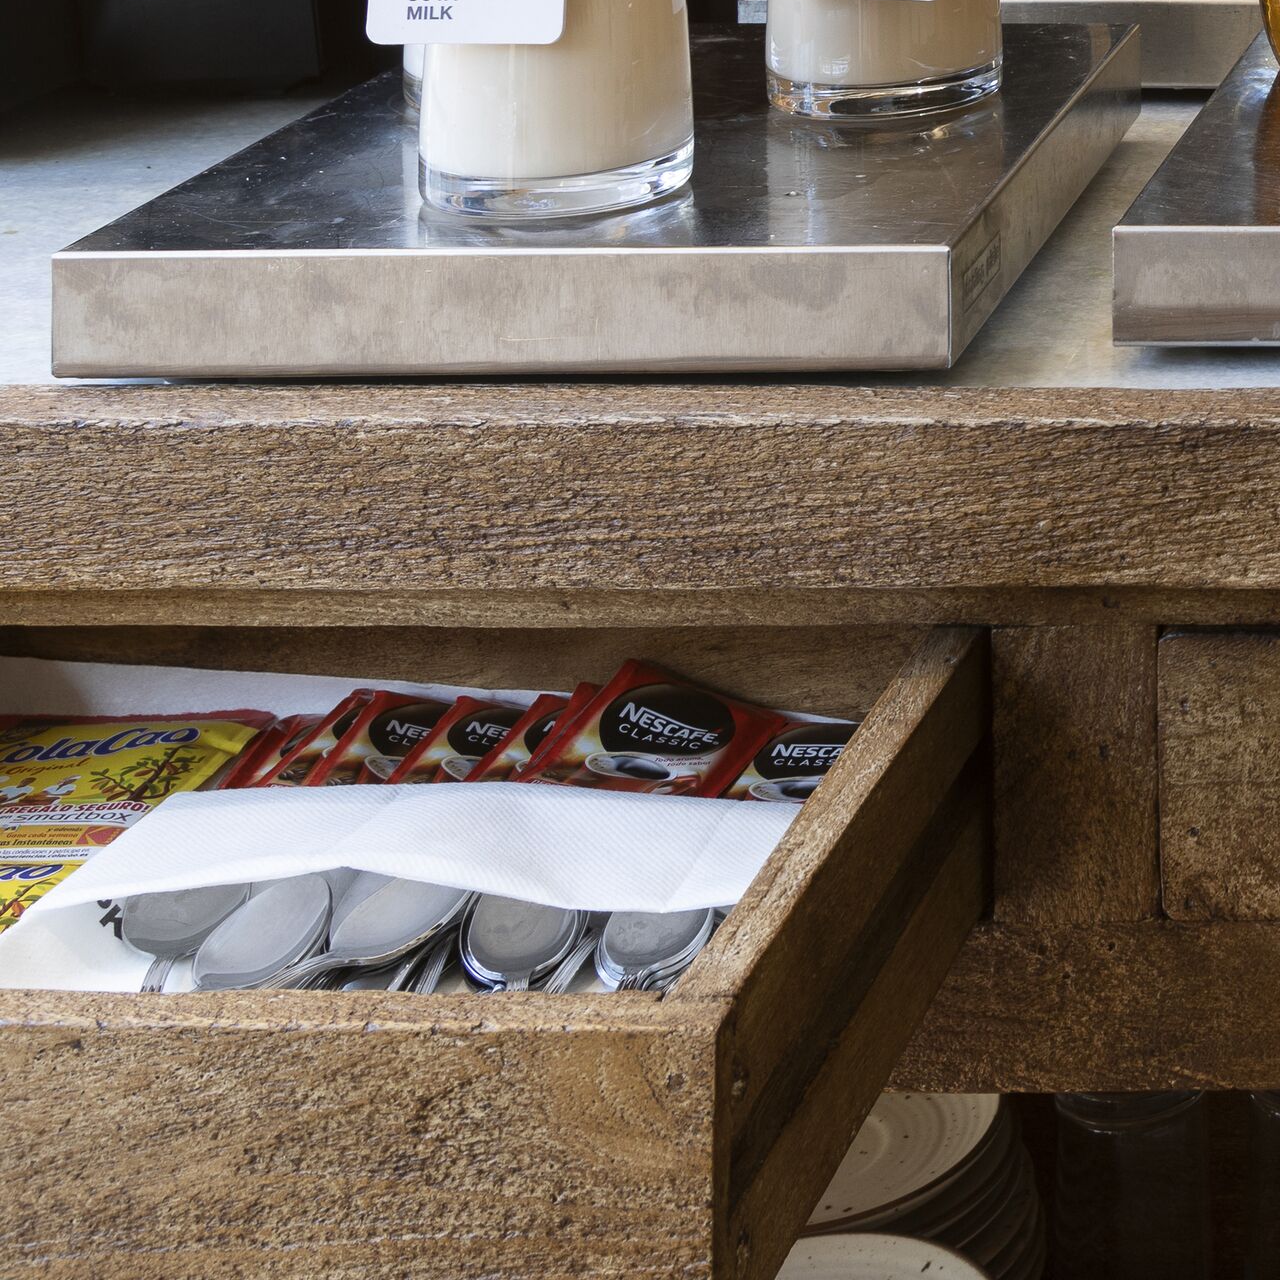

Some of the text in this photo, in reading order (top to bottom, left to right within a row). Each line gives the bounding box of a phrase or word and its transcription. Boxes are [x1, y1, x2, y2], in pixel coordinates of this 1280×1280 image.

[407, 6, 453, 20] MILK
[619, 723, 701, 749] CLASSIC
[75, 801, 150, 813] SEGURO!
[15, 811, 132, 822] smartbox
